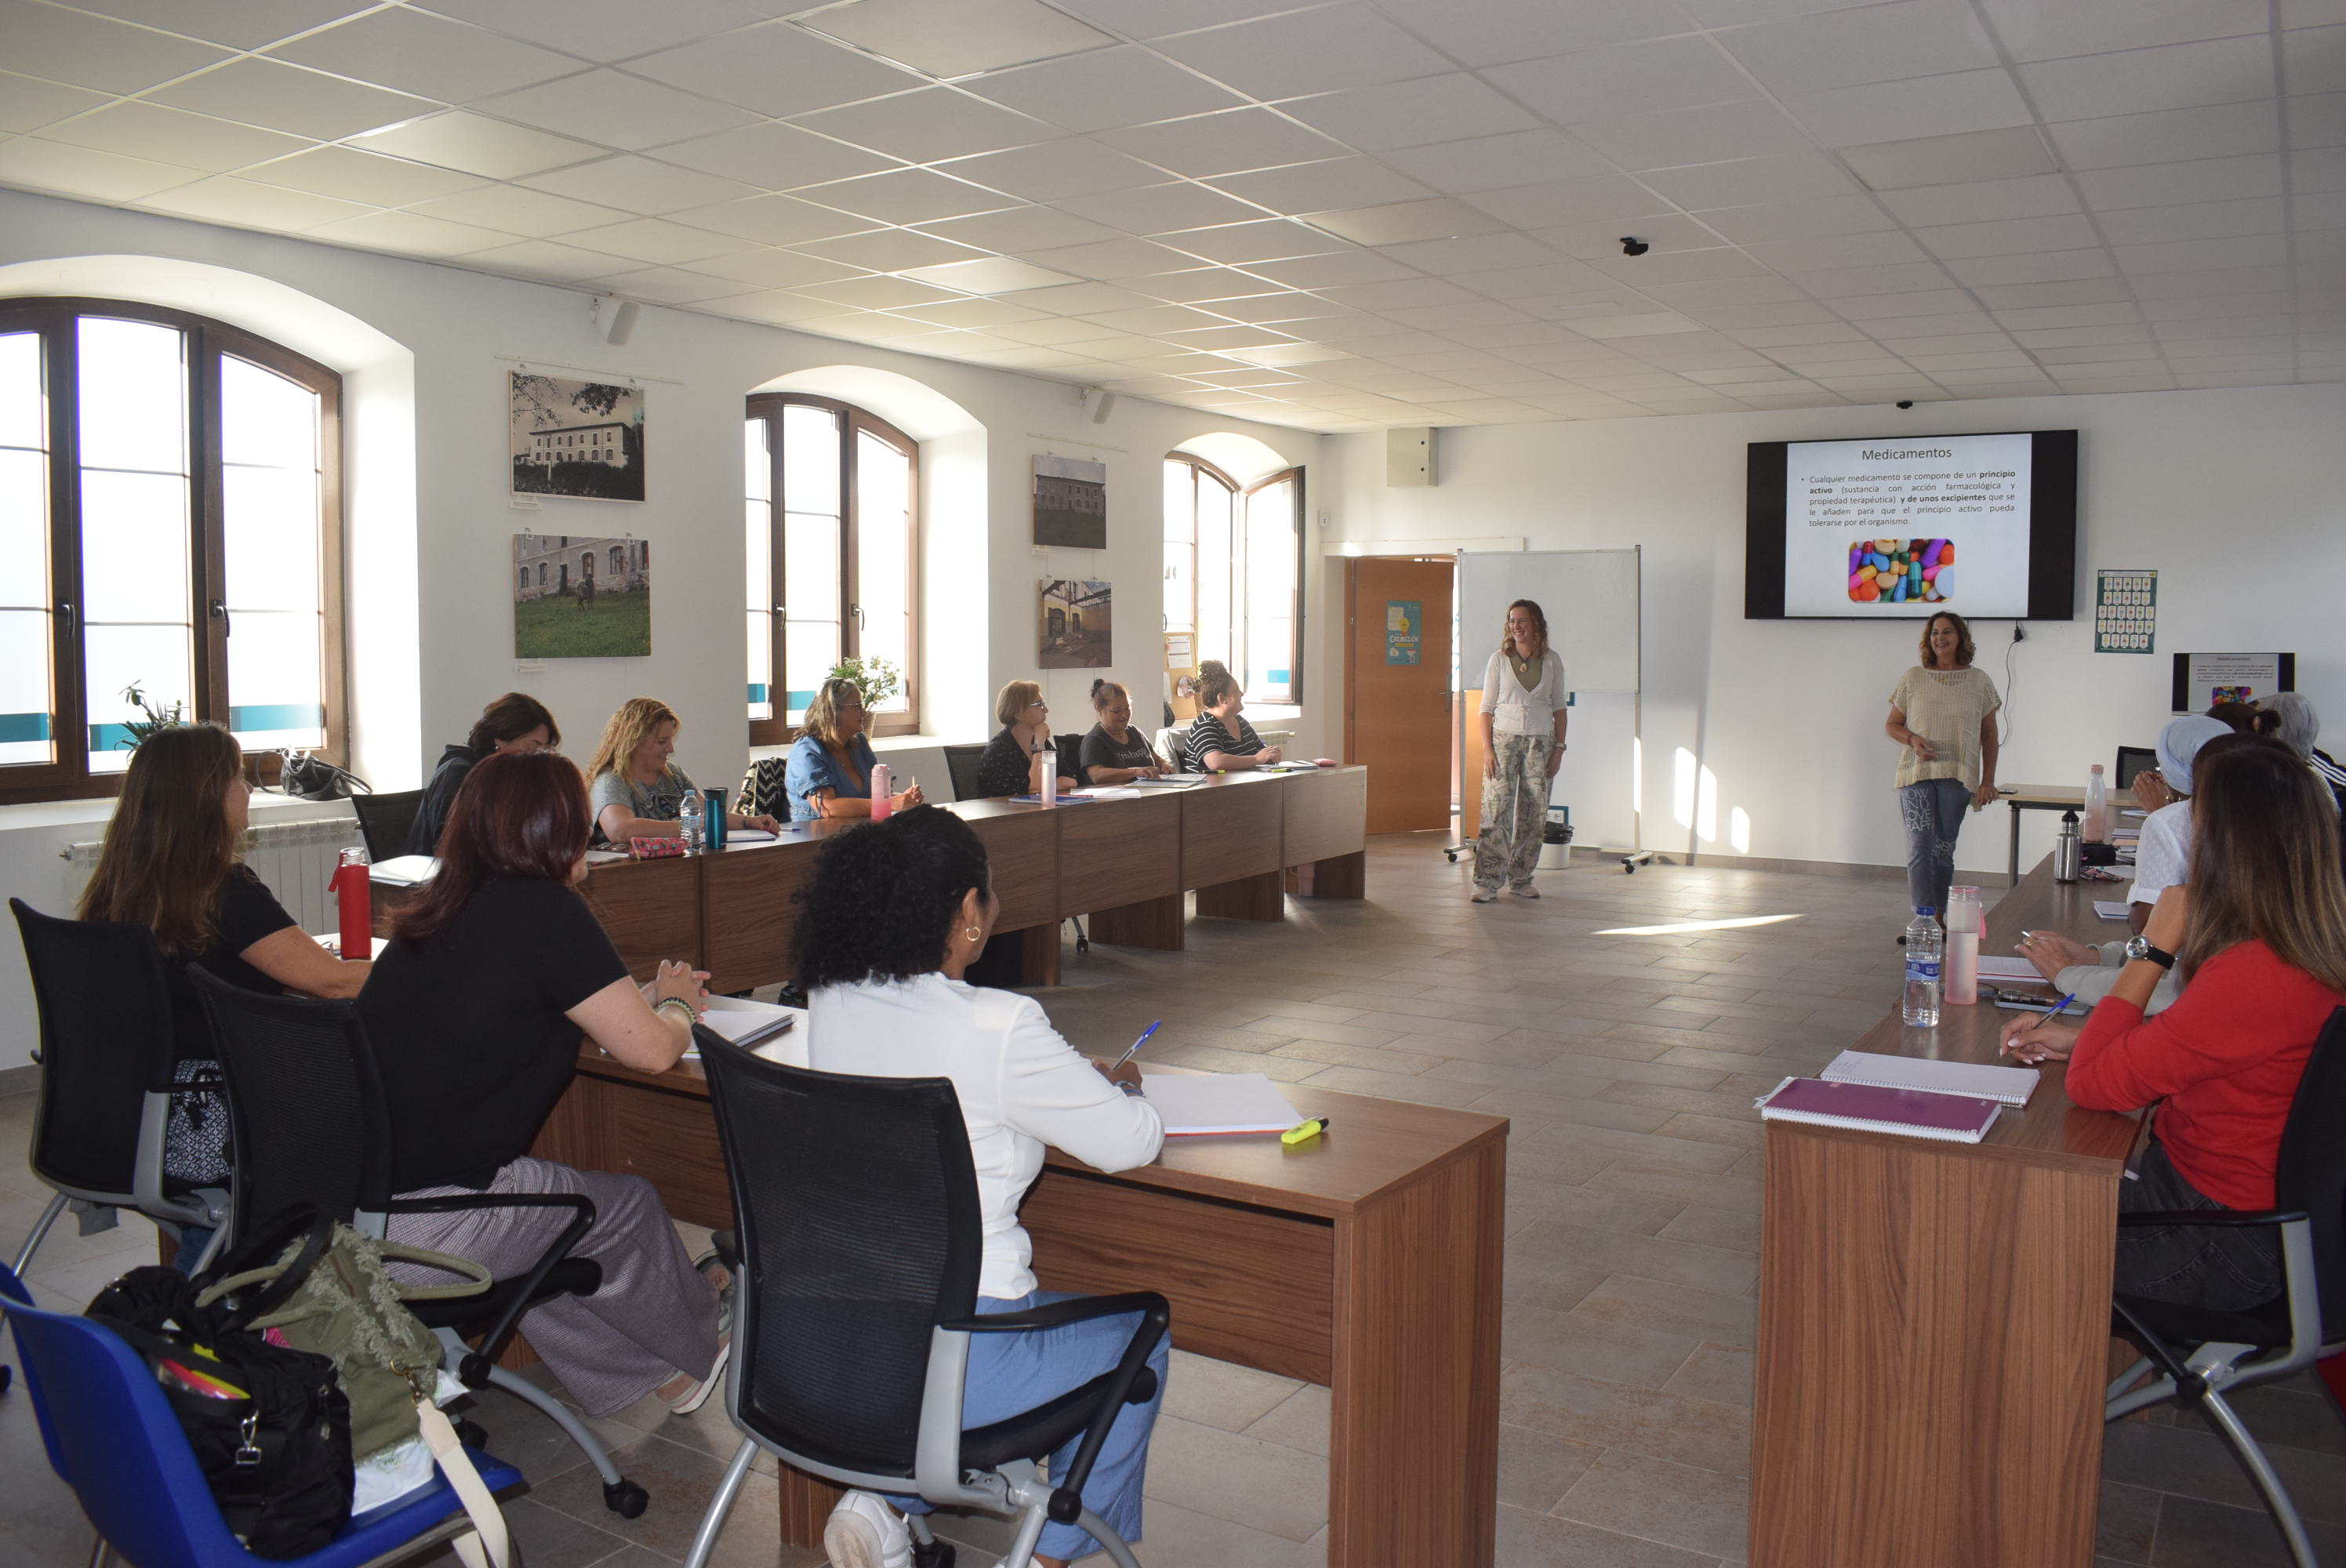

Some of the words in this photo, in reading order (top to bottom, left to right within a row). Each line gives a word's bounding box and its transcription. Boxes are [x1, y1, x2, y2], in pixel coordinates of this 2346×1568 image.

[1862, 448, 1952, 460] Medicamentos
[1810, 475, 1845, 484] Cualquier
[1979, 470, 2016, 479] principio
[1841, 485, 1879, 494] (sustancia
[1945, 481, 2001, 491] farmacológica
[1810, 497, 1847, 506] propiedad
[1850, 495, 1896, 504] terapéutica)
[1941, 494, 1986, 503] excipientes
[1917, 506, 1952, 514] principio
[1989, 504, 2015, 513] pueda
[1868, 518, 1911, 527] organismo.
